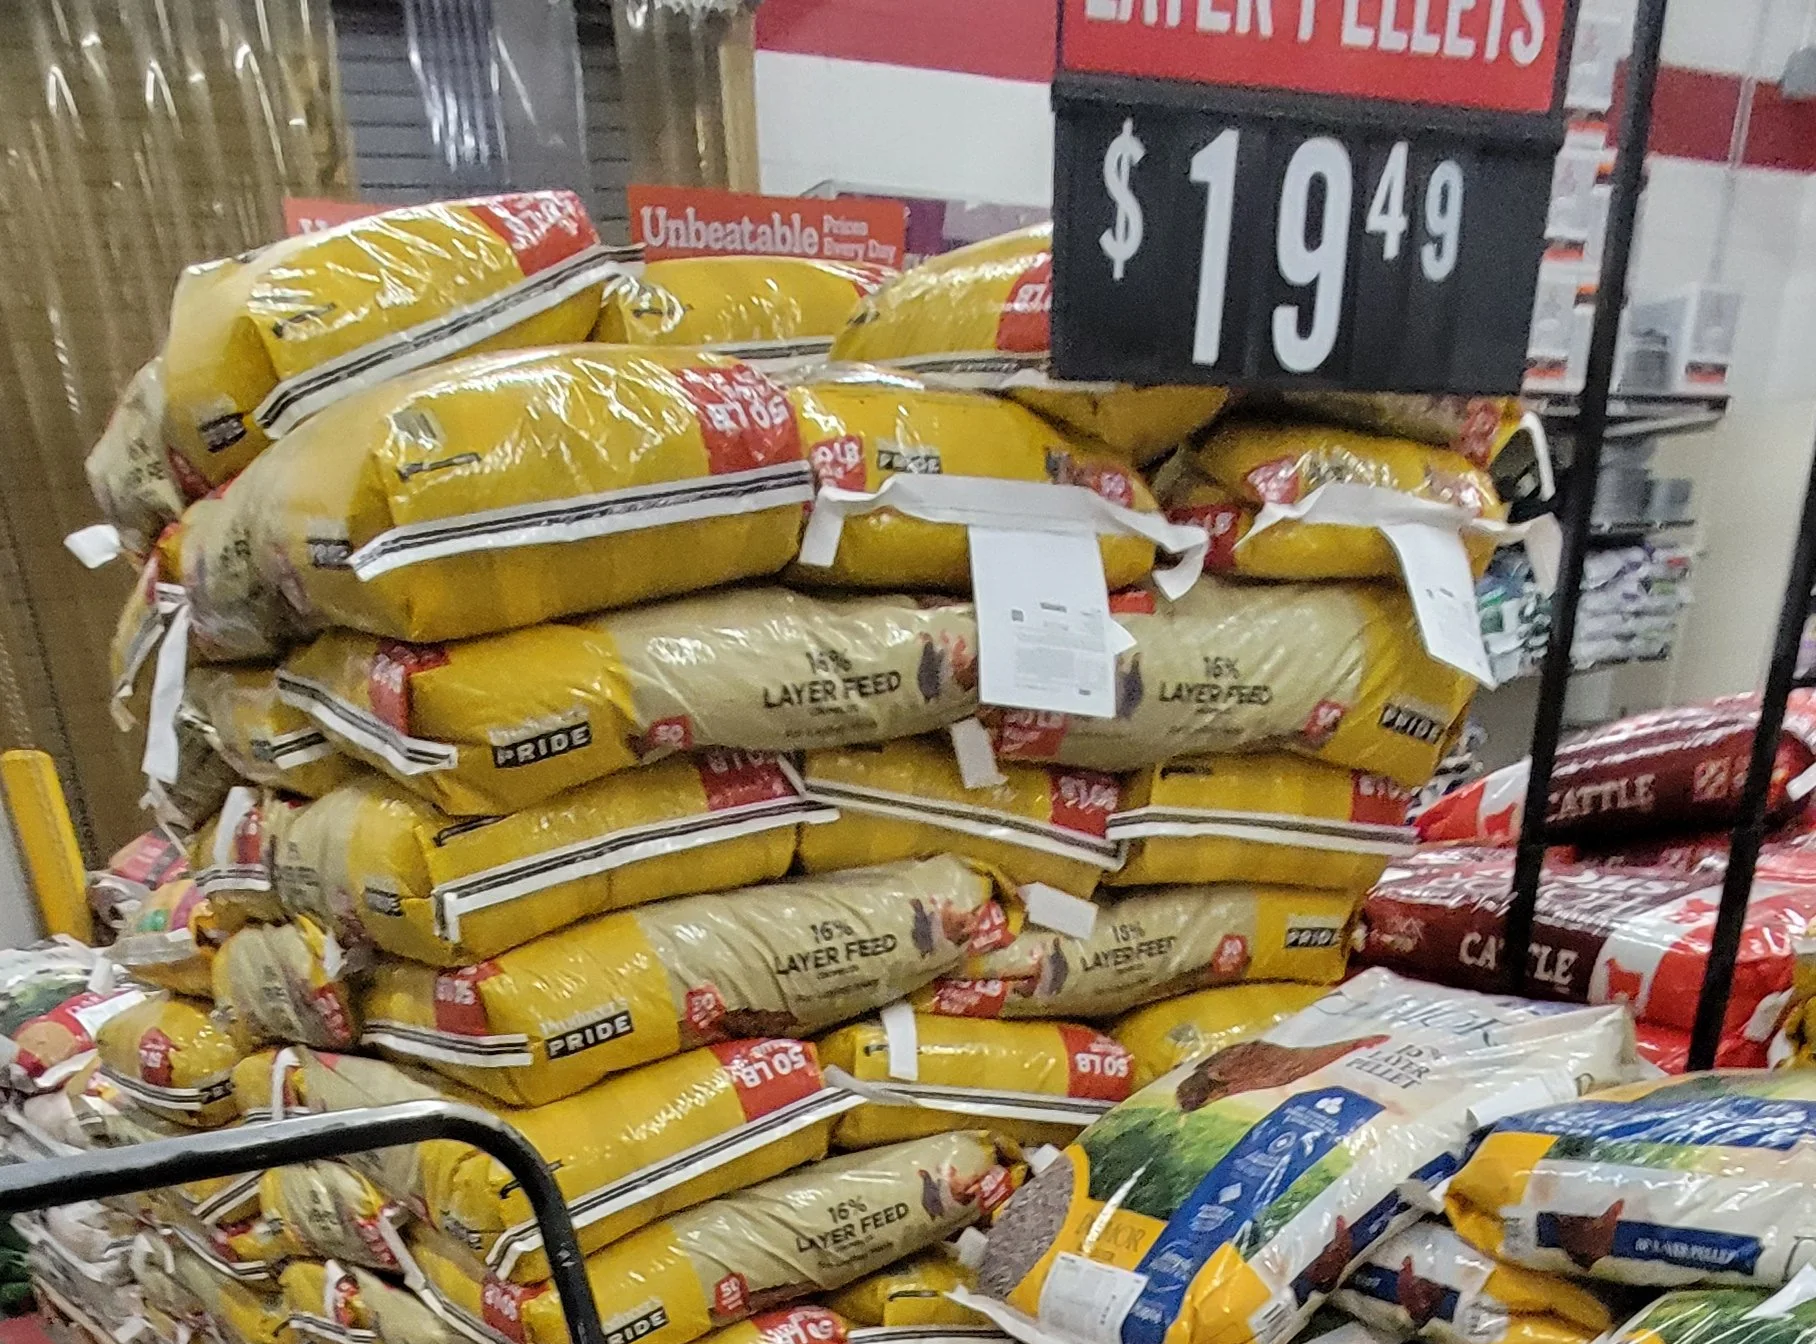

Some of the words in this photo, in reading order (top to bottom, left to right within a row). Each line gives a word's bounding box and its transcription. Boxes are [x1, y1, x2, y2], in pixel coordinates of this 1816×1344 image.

[640, 204, 819, 257] Unbeatable
[868, 239, 898, 265] Day
[764, 678, 839, 709] LAYER
[844, 670, 901, 701] FEED
[497, 723, 591, 767] PRIDE
[775, 946, 838, 976] LAYER
[846, 933, 898, 960] FEED
[1459, 931, 1580, 986] CALE
[548, 1010, 634, 1059] PRIDE
[1345, 1057, 1422, 1090] PELLET
[1367, 1050, 1431, 1079] LAYER
[796, 1223, 858, 1254] LAYER
[861, 1202, 910, 1234] FEED
[828, 1197, 869, 1224] 16%
